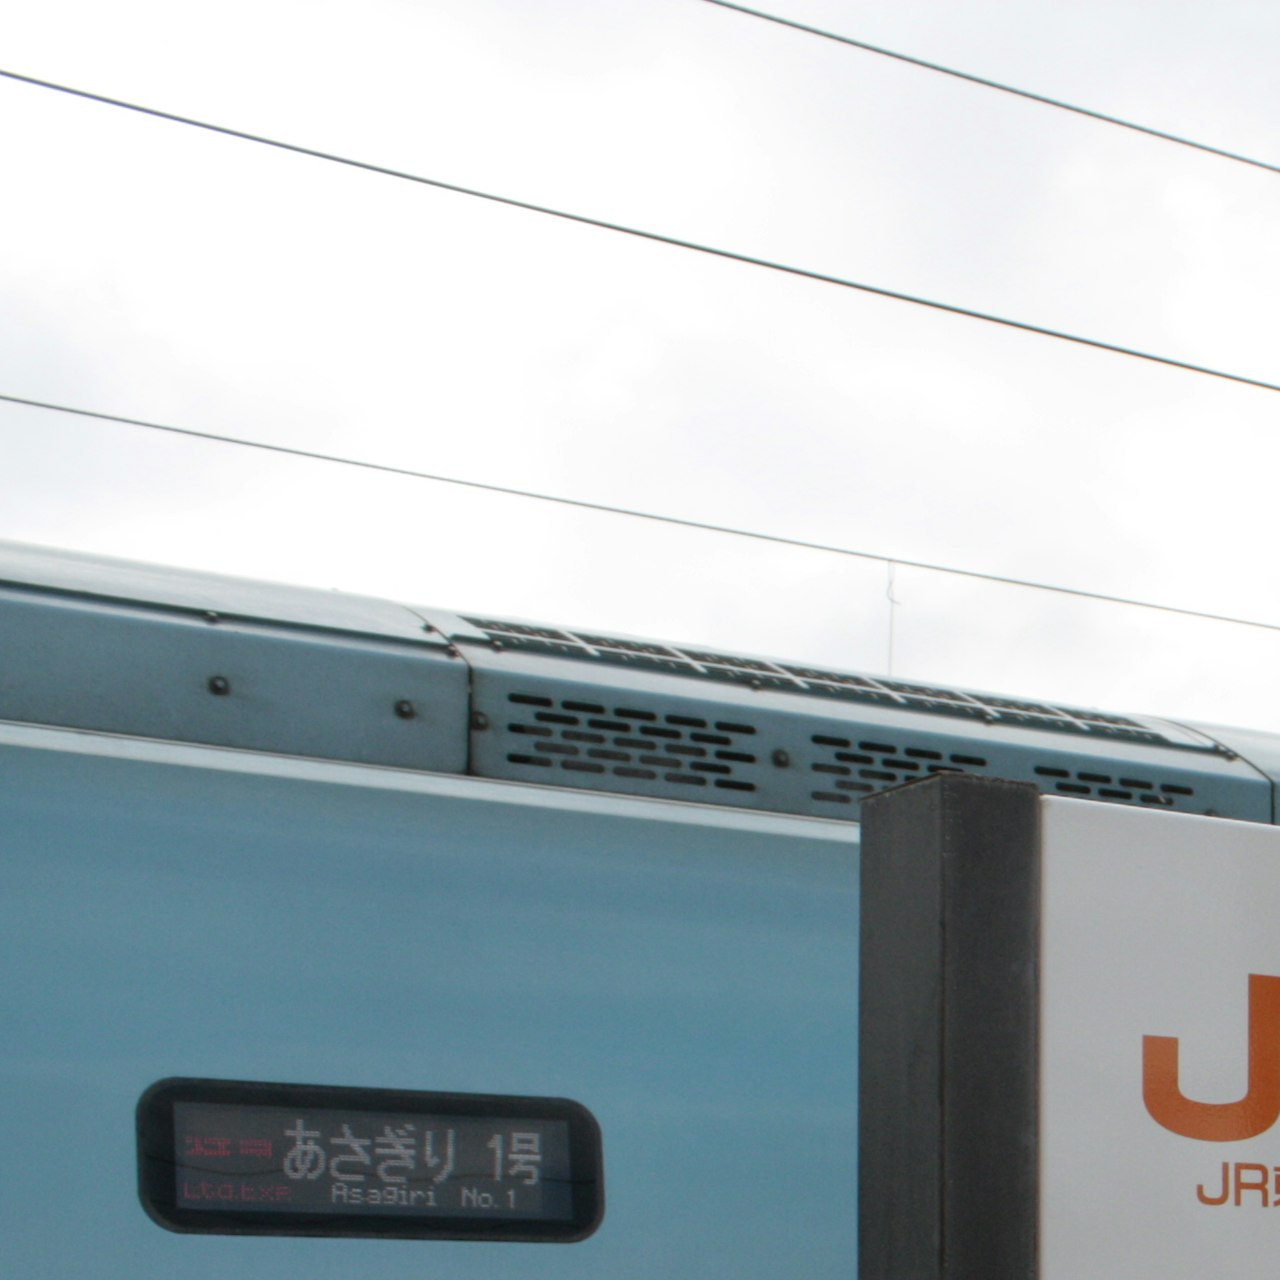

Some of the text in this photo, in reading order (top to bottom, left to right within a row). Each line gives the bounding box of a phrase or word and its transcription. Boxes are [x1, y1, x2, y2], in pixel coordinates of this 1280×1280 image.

[283, 1118, 455, 1184] あさぎり
[331, 1182, 438, 1207] Asagiri
